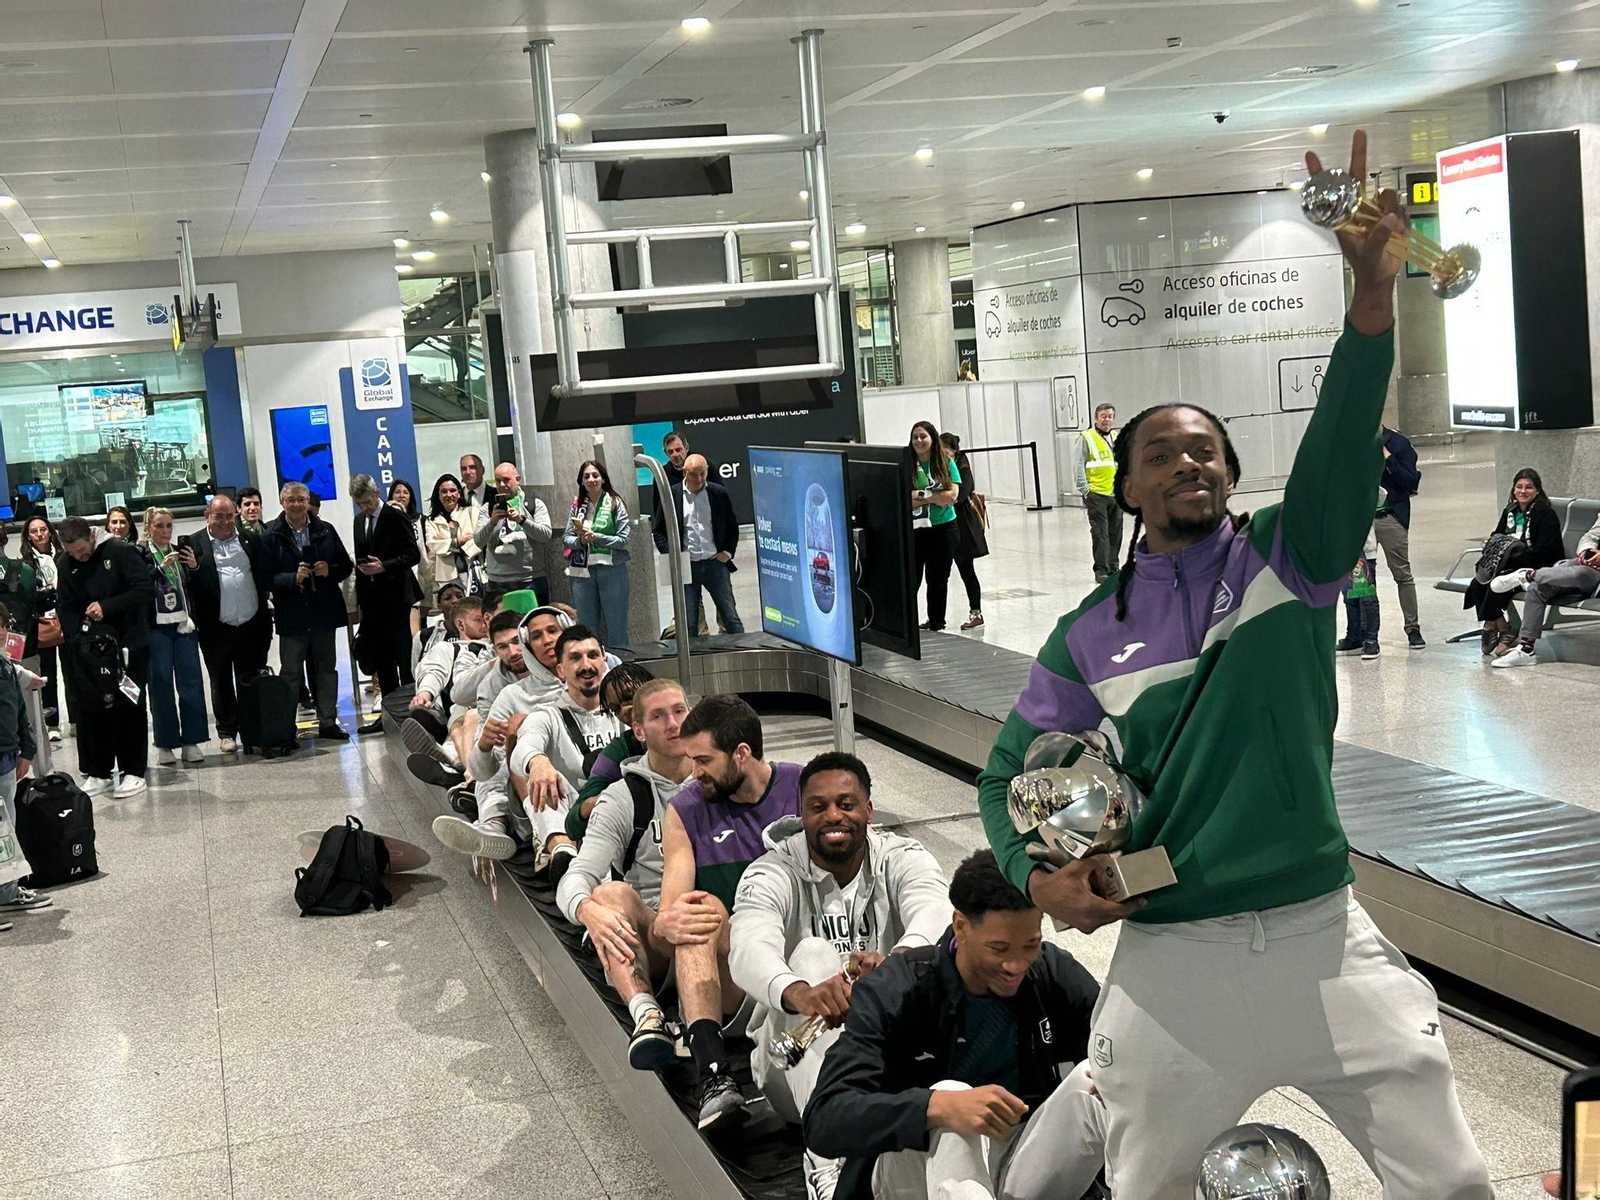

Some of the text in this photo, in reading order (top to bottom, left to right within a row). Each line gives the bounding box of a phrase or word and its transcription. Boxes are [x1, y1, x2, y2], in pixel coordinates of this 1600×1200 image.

[1163, 268, 1299, 292] Acceso oficinas de
[1006, 287, 1058, 307] Acceso oficinas de
[1164, 296, 1304, 321] alquiler de coches
[1007, 314, 1061, 336] alquiler de coches
[1167, 325, 1340, 350] Access to car rental offices
[757, 515, 772, 532] Volver
[758, 535, 798, 556] te costará menos
